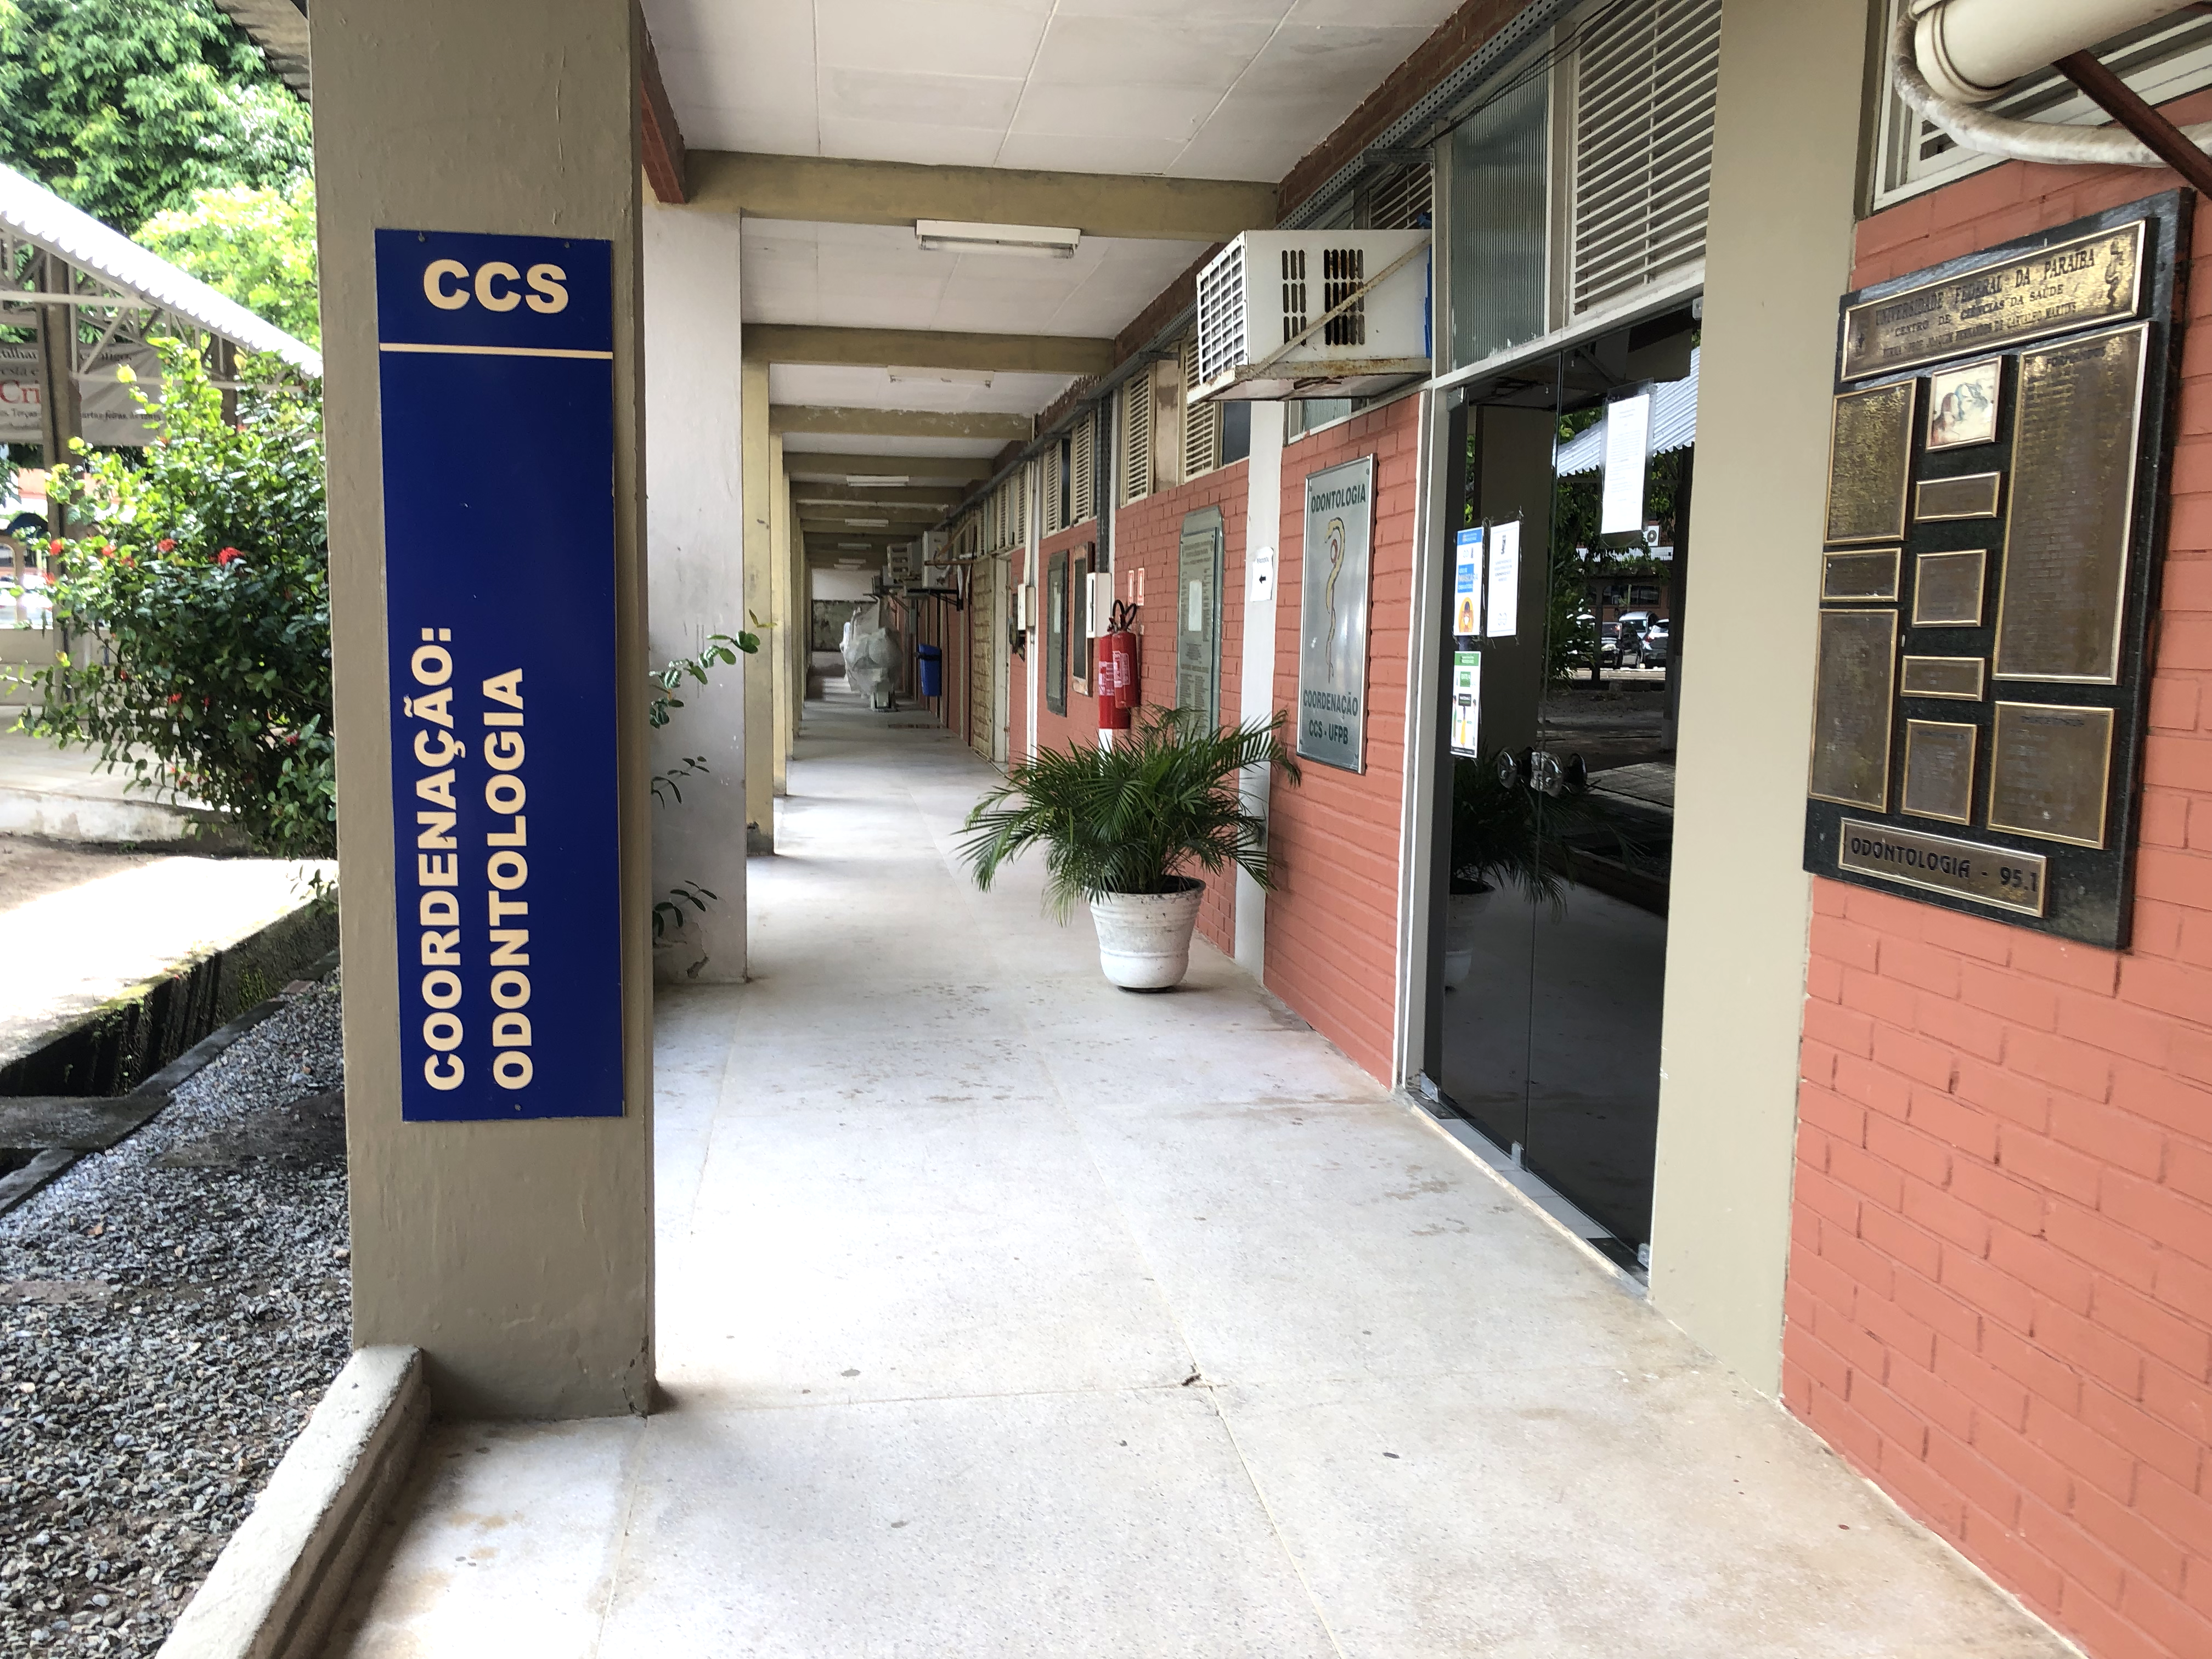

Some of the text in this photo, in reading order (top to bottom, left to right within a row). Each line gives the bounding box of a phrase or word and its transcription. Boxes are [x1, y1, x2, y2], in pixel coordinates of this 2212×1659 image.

[424, 259, 569, 313] CCS
[1311, 483, 1366, 514] ODONTOLOGIA
[1303, 690, 1358, 719] COORDENAÇÃO
[1309, 719, 1323, 738] CCS
[1329, 723, 1348, 744] UFPB
[404, 627, 466, 1092] COORDENAÇÃO:
[1851, 838, 1971, 878] ODONTOLOGIA
[483, 668, 534, 1090] ODONTOLOGIA
